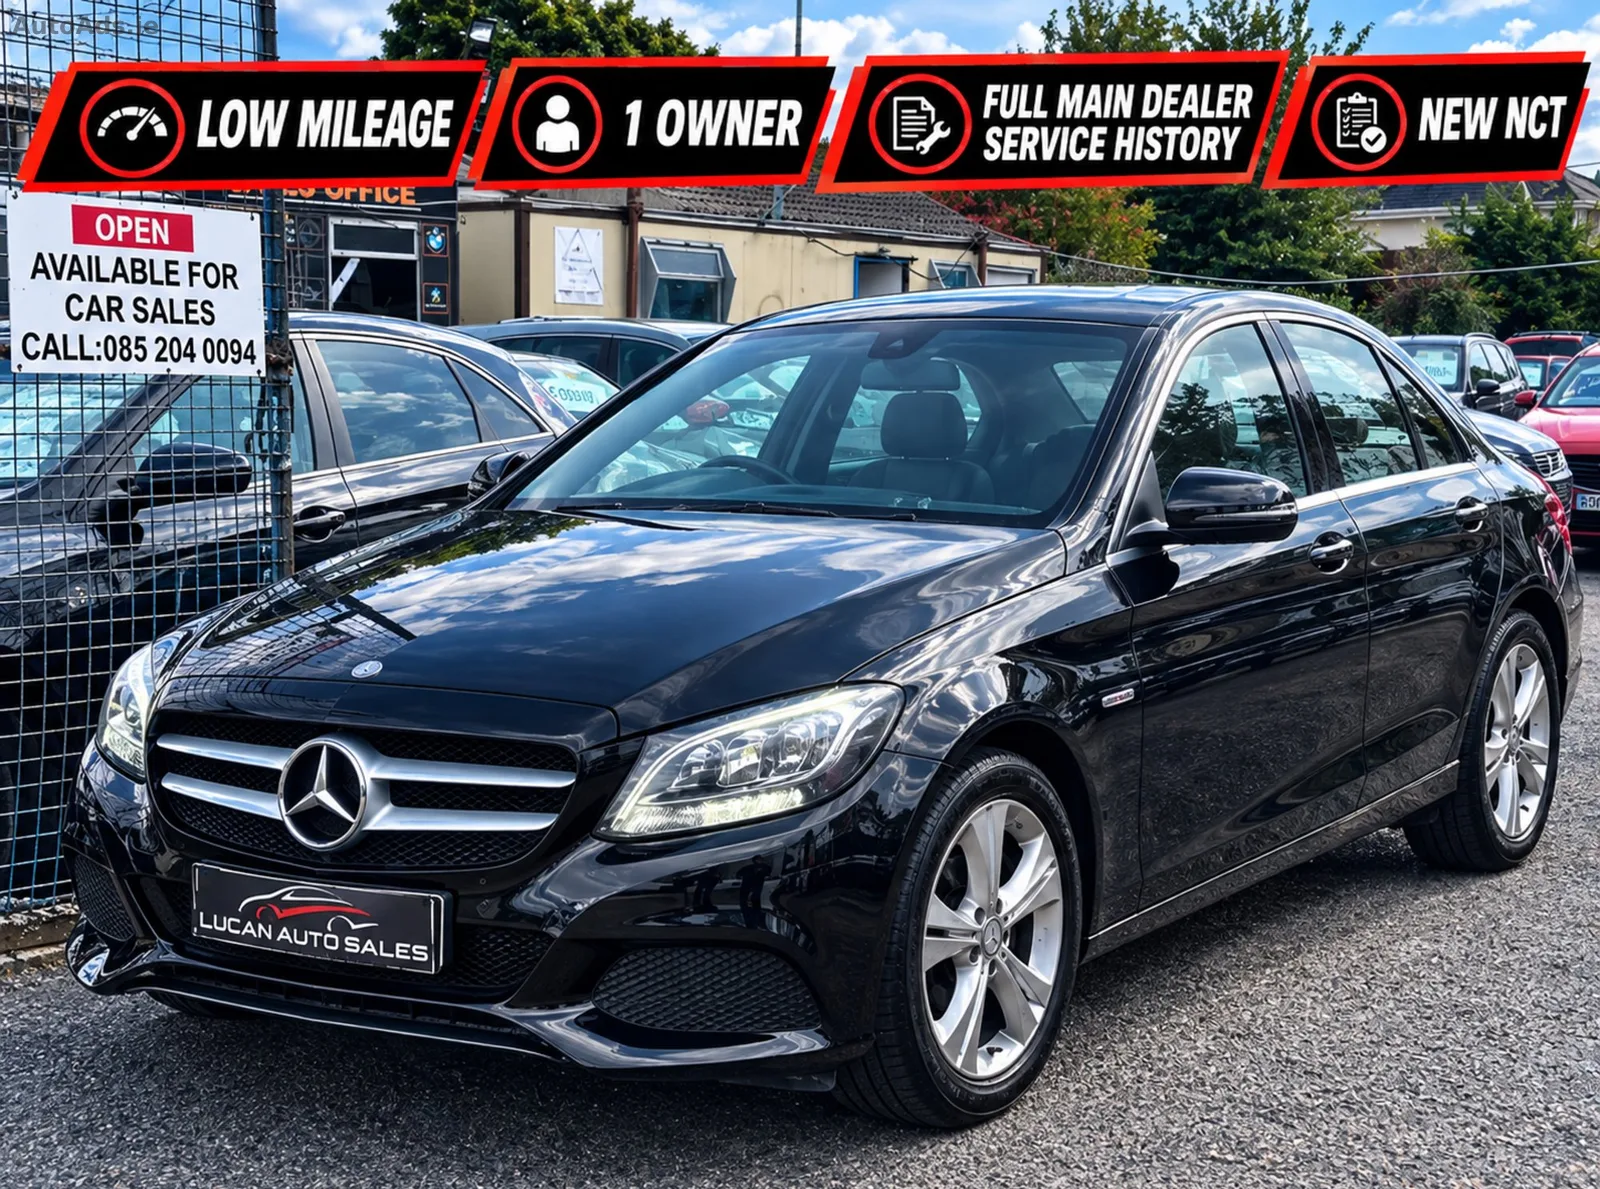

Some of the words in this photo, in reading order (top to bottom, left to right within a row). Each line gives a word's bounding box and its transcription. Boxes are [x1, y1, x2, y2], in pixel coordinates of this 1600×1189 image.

[324, 186, 416, 206] OFFICE
[95, 213, 170, 245] OPEN
[30, 252, 181, 287] AVAILABLE
[188, 261, 239, 290] FOR
[65, 293, 125, 323] CAR
[132, 296, 216, 326] SALES
[21, 332, 148, 363] CALL:085
[154, 336, 197, 363] 204
[202, 337, 257, 365] 0094
[199, 911, 272, 940] LUCAN
[276, 926, 339, 951] AUTO
[344, 935, 429, 962] SALES
